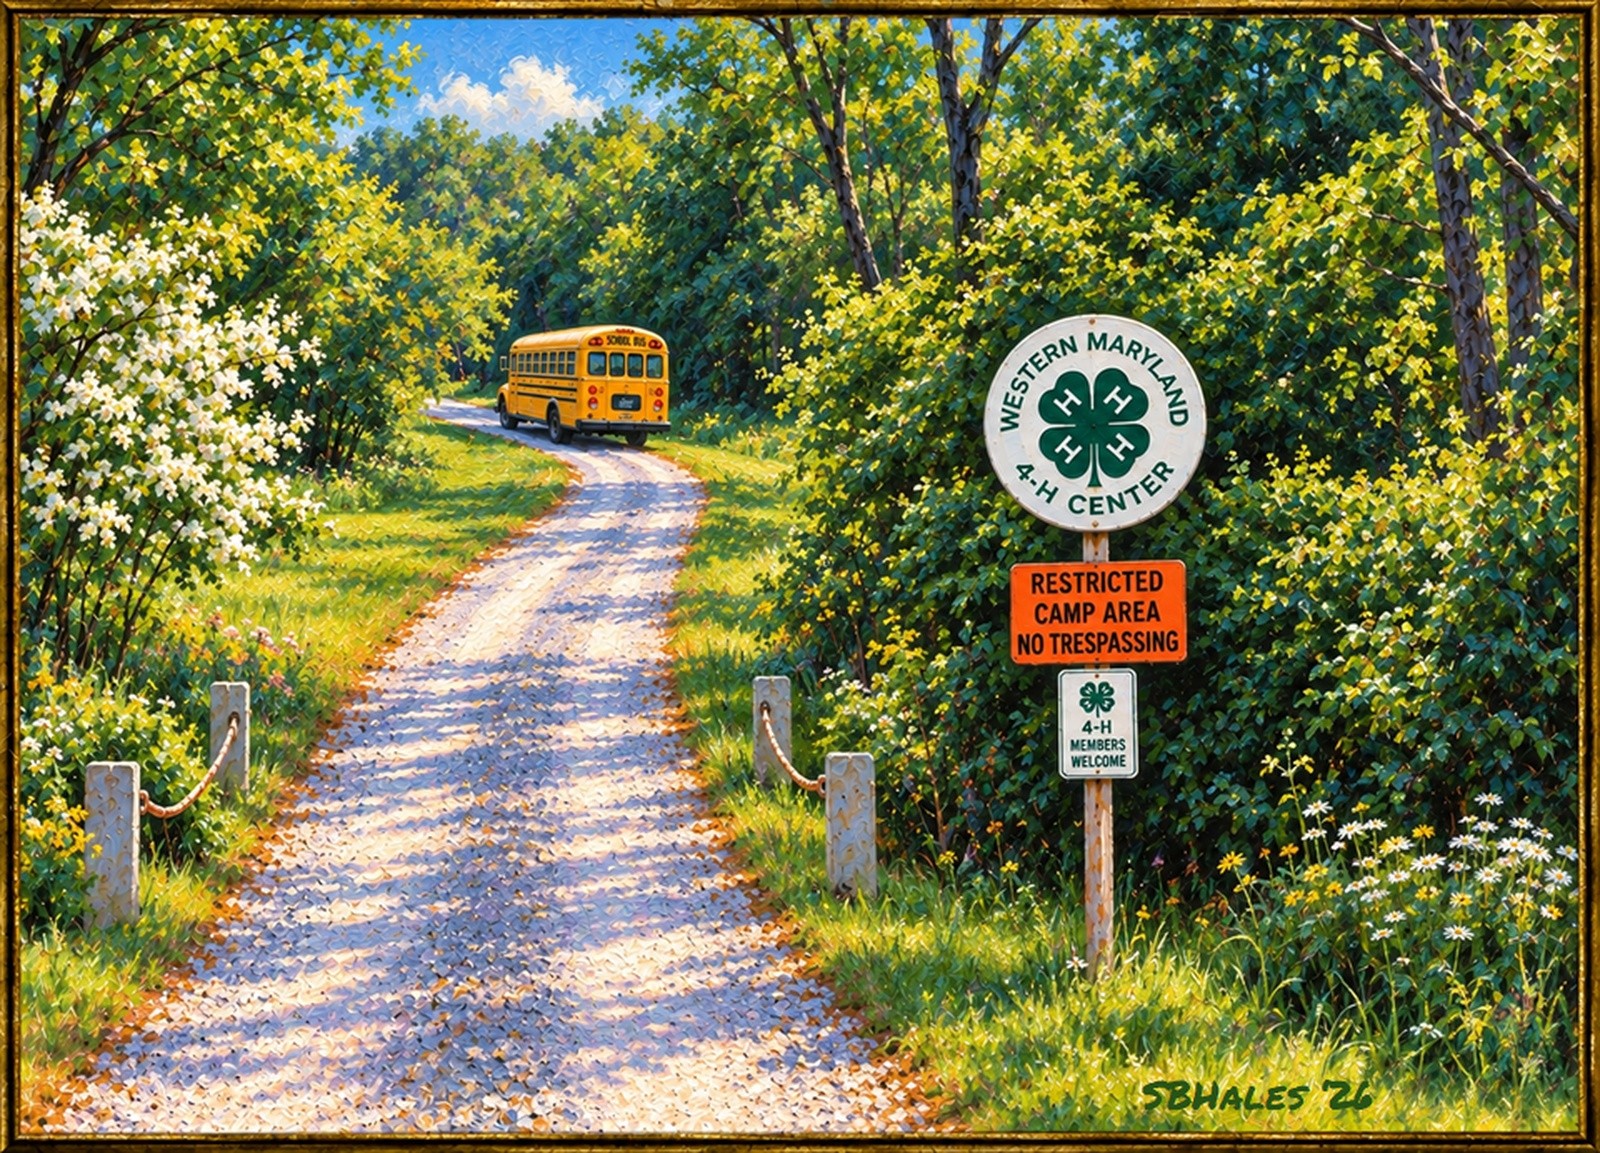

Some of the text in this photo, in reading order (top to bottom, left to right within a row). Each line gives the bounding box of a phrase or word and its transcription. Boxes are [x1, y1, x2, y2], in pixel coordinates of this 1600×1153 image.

[1000, 332, 1189, 432] WESTERN MARYLAND
[1016, 461, 1174, 515] 4-H CENTER
[1031, 570, 1163, 594] RESTRICTED
[1034, 600, 1161, 625] CAMP AREA
[1018, 630, 1179, 655] NO TRESPASSING
[1082, 720, 1112, 734] 4-H
[1070, 738, 1126, 751] MEMBERS
[1071, 755, 1126, 768] WELCOME
